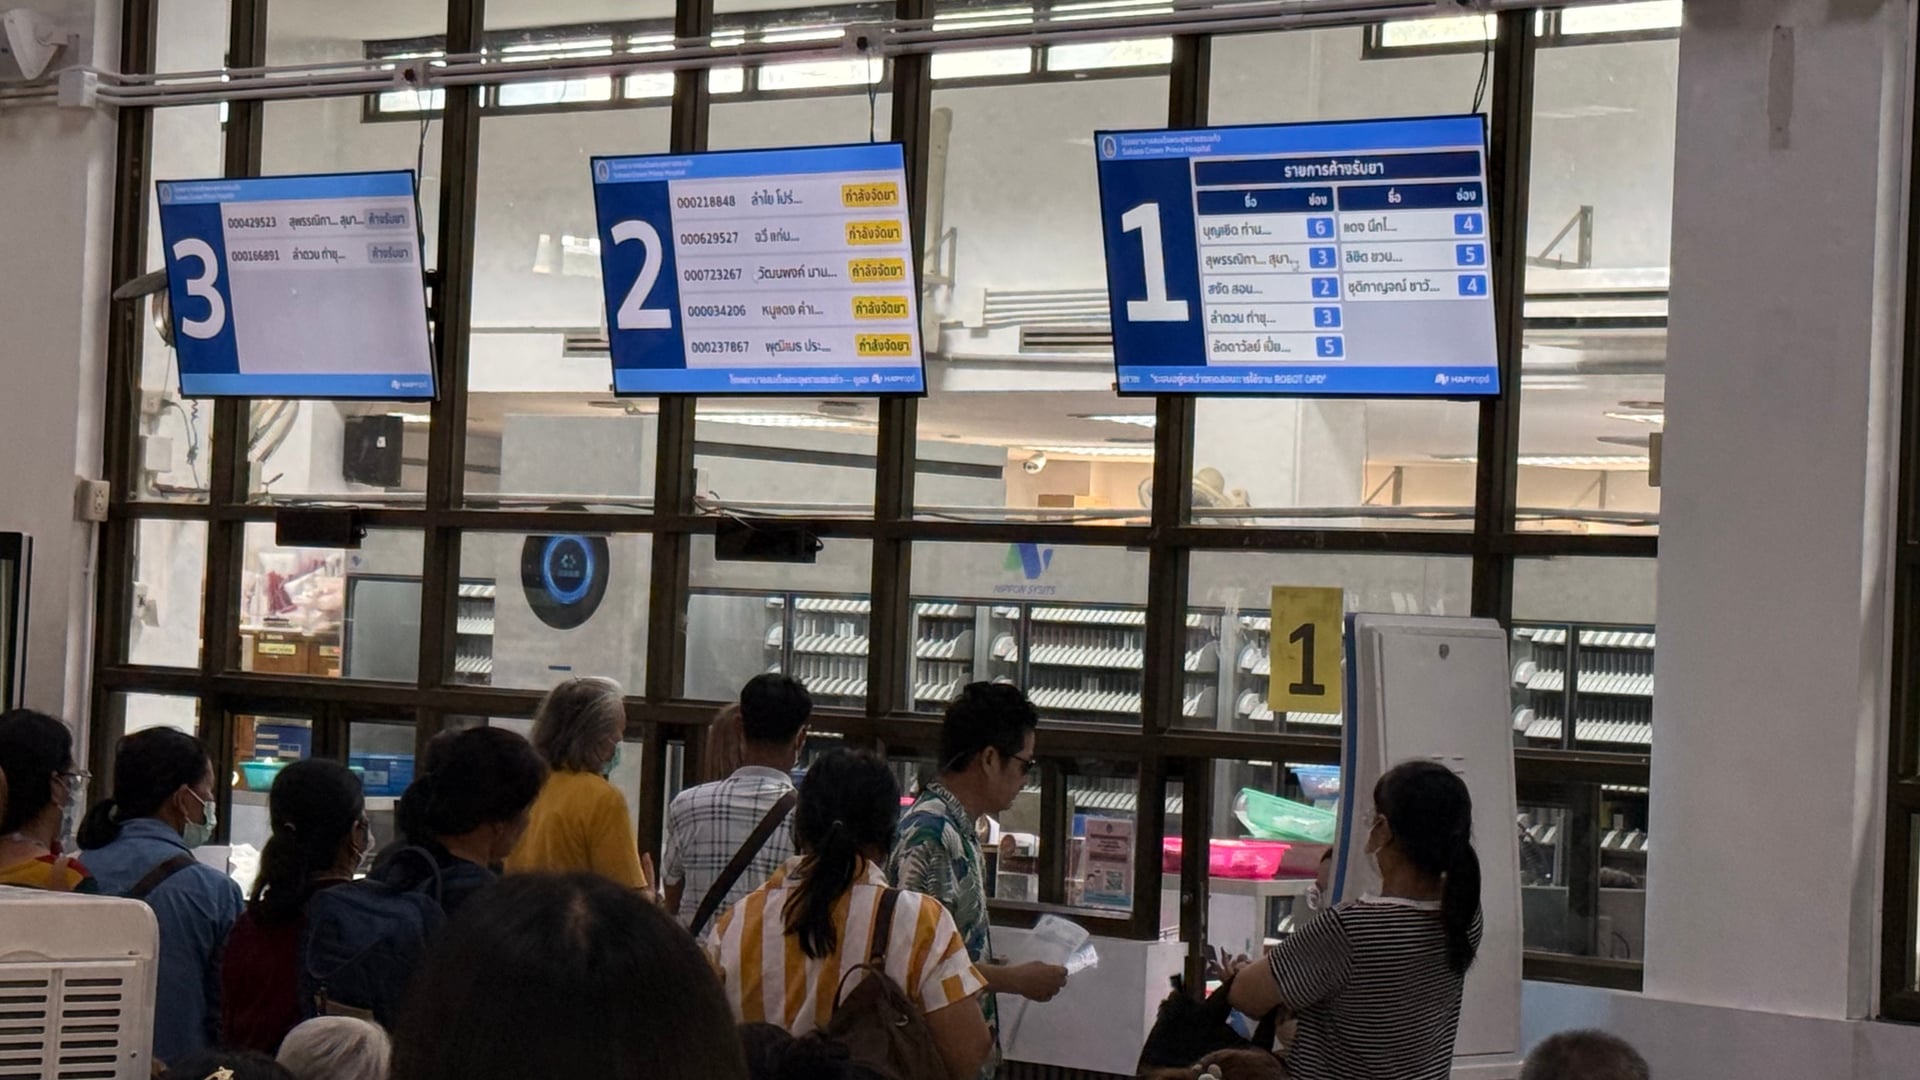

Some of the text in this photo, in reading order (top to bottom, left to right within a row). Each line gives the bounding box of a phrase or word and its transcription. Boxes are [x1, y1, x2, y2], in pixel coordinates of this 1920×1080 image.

[1284, 159, 1385, 178] รายการค้างรับยา
[677, 194, 736, 209] 000218848
[845, 187, 896, 206] กำลังจัดยา
[1244, 191, 1328, 208] ชื่อ ช่อง
[1388, 187, 1477, 203] ชื่อ ช่อง
[228, 216, 277, 229] 000429523
[1315, 220, 1326, 235] 6
[1463, 216, 1474, 231] 4
[680, 231, 738, 245] 000629527
[849, 224, 900, 243] กำลังจัดยา
[231, 249, 280, 262] 000166891
[1121, 202, 1190, 322] 1
[1318, 250, 1328, 265] 3
[1465, 247, 1475, 262] 5
[611, 219, 673, 330] 2
[684, 268, 742, 281] 000723267
[852, 262, 903, 279] กำลังจัดยา
[172, 237, 226, 340] 3
[1320, 280, 1330, 295] 2
[1466, 278, 1478, 293] 4
[688, 304, 746, 317] 000034206
[855, 299, 906, 317] กำลังจัดยา
[1322, 309, 1332, 325] 3
[691, 340, 749, 354] 000237867
[859, 337, 909, 354] กำลังจัดยา
[1324, 339, 1335, 354] 5
[1289, 623, 1325, 695] 1
